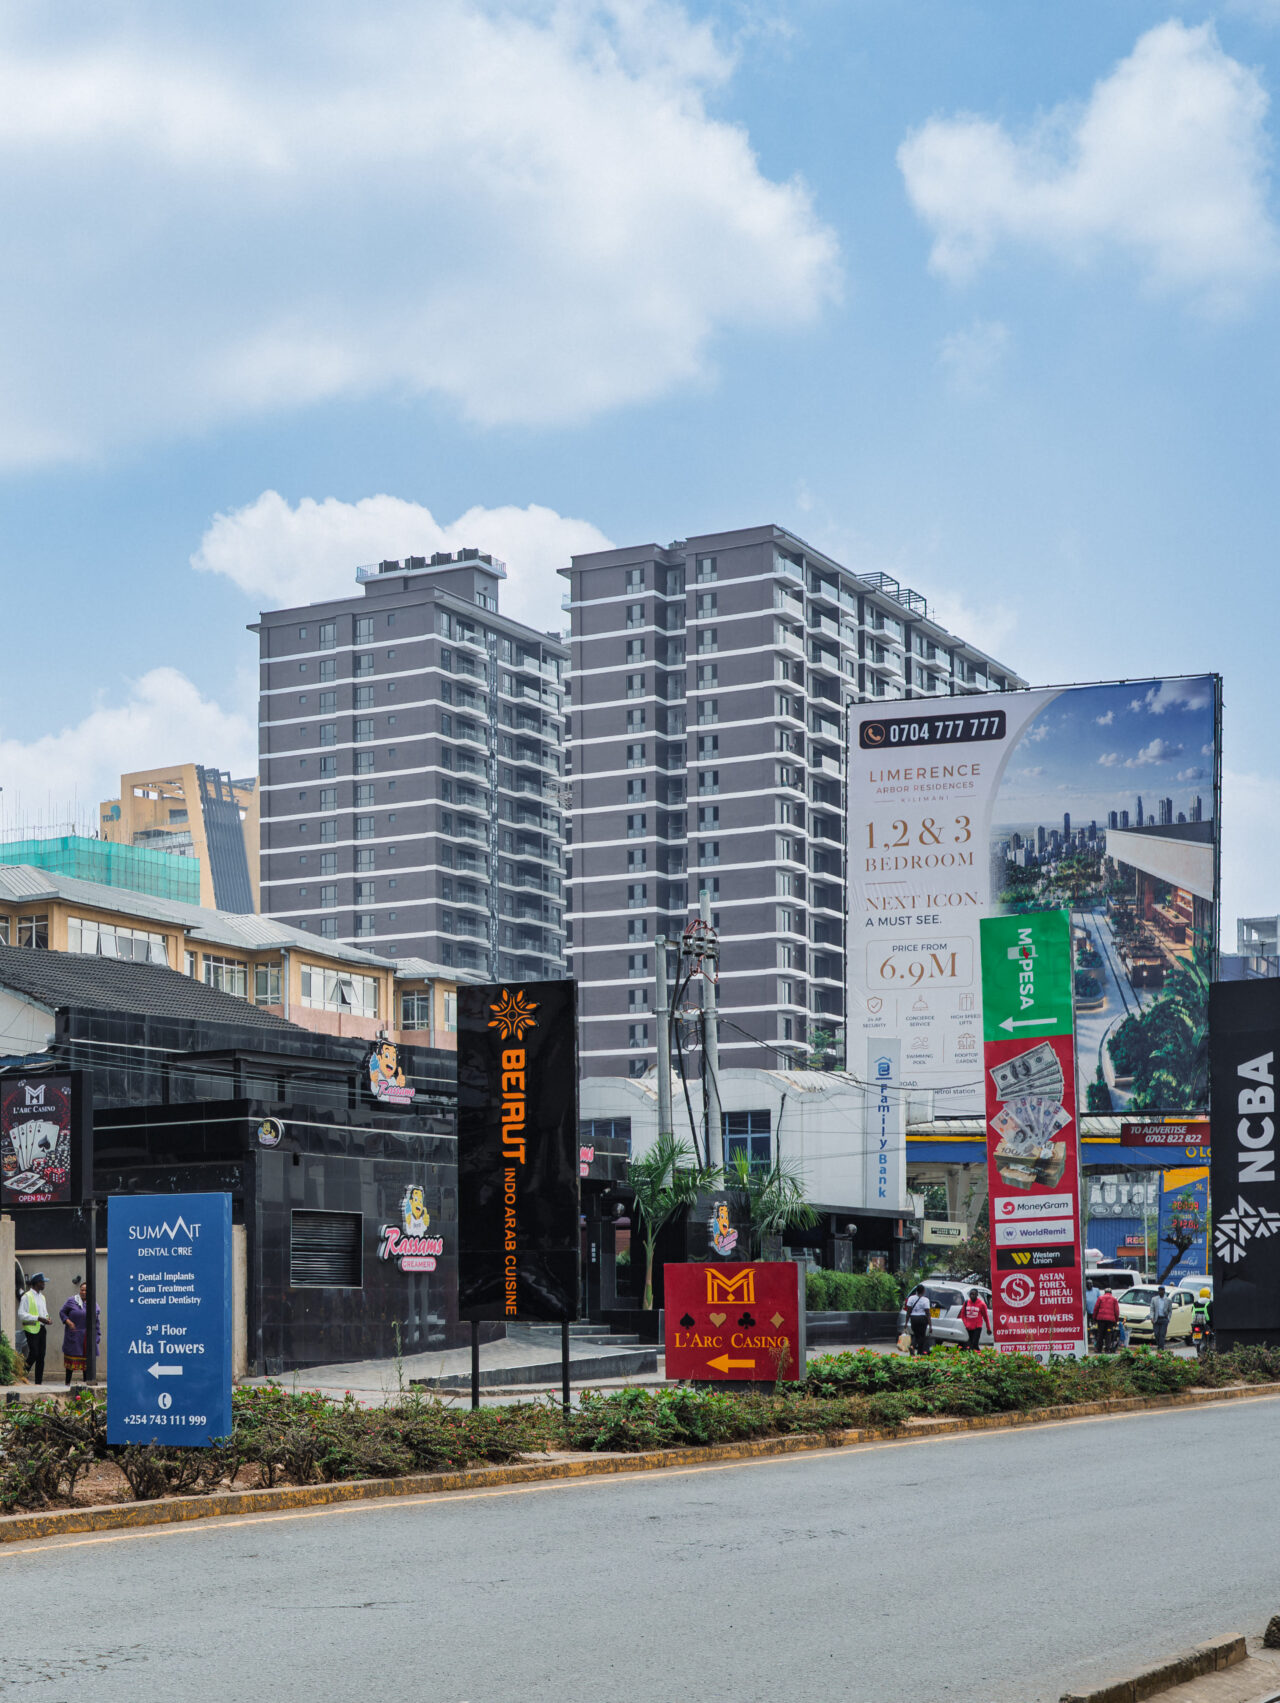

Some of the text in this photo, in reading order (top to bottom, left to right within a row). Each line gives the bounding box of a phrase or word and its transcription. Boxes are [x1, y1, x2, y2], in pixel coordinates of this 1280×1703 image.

[889, 717, 1000, 743] 0704 777 777
[869, 763, 982, 783] LIMERENCE
[876, 781, 975, 794] ARBOR RESIDENCES
[918, 817, 945, 846] &
[954, 815, 972, 844] 3
[865, 852, 975, 872] BEDROOM
[865, 891, 984, 911] NEXT ICON.
[865, 914, 942, 927] A MUST SEE.
[892, 943, 948, 953] PRICE FROM
[879, 952, 959, 987] 6.9M
[501, 1048, 527, 1165] BEIRUT
[1237, 1051, 1276, 1183] NCBA
[1130, 1125, 1187, 1134] TO ADVERTISE
[1145, 1134, 1202, 1143] 0702 822 822
[36, 1194, 52, 1202] 24/7
[1017, 1202, 1069, 1212] MoneyGram
[1019, 1226, 1067, 1237] WorldRemit
[381, 1226, 444, 1259] Rassams
[504, 1167, 518, 1316] INDO ARAB CUISINE
[138, 1247, 170, 1257] DENTAL
[1032, 1251, 1061, 1259] Western
[1032, 1257, 1053, 1265] Union
[137, 1271, 195, 1283] Dental Implants
[1038, 1272, 1065, 1281] ASTAN
[137, 1283, 195, 1294] Gum Treatment
[1039, 1280, 1067, 1289] FOREX
[1039, 1288, 1073, 1297] BUREAU
[137, 1295, 202, 1306] General Dentistry
[1039, 1296, 1074, 1305] LIMITED
[1007, 1313, 1075, 1324] ALTER TOWERS
[146, 1324, 188, 1336] 3rd Floor
[128, 1340, 206, 1355] Alta Towers
[123, 1414, 207, 1426] +254 743 111 999
